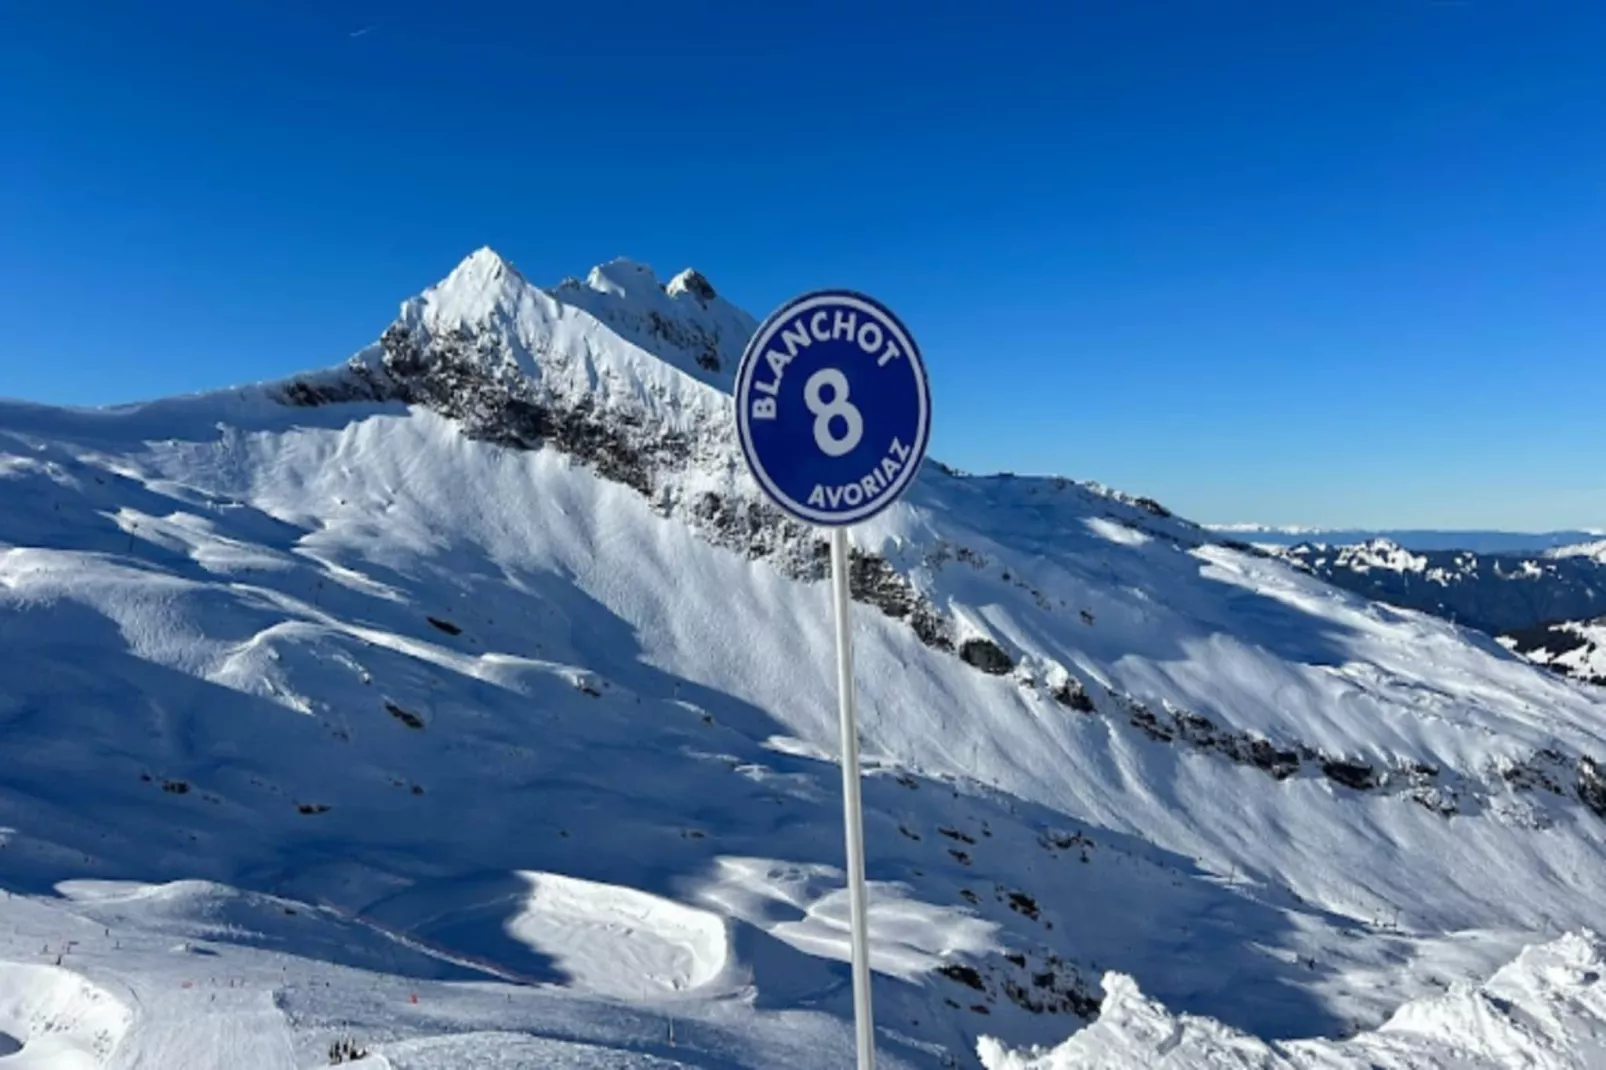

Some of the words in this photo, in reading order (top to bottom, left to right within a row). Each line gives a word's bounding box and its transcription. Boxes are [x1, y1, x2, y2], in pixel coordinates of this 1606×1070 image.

[752, 310, 901, 420] BLANCHOT
[804, 368, 863, 457] 8
[807, 436, 910, 509] AVORIAZ
